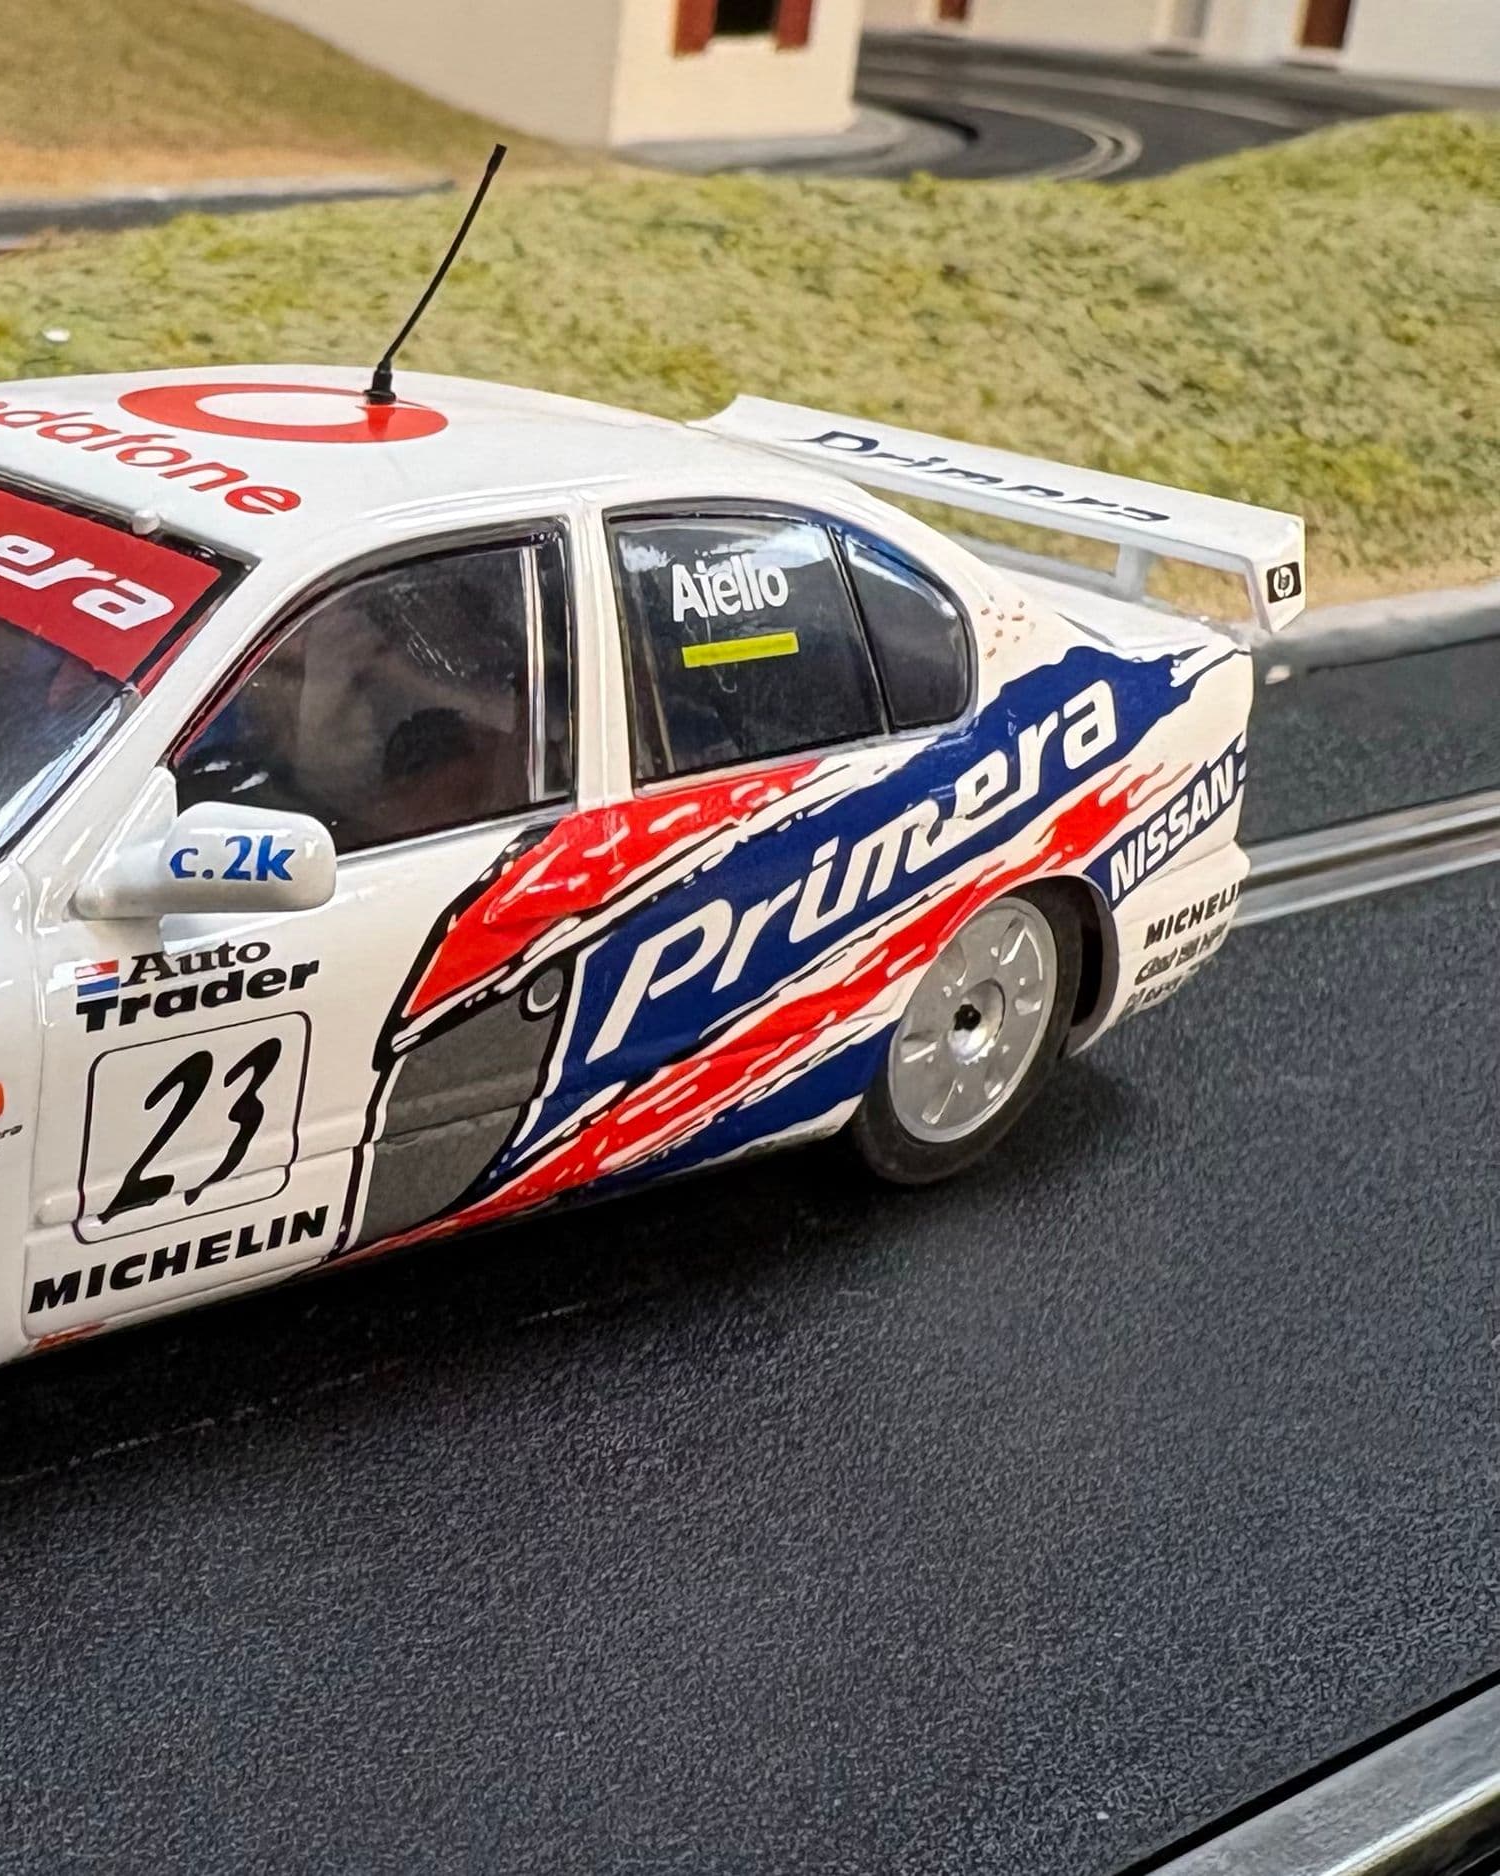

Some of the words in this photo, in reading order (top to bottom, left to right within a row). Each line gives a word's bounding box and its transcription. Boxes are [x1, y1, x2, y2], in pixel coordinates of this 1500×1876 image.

[672, 552, 789, 622] Aiello
[169, 835, 293, 881] c.2k
[584, 679, 1118, 1064] Primera
[1109, 754, 1234, 901] NISSAN
[76, 960, 319, 1033] Trader
[120, 940, 271, 986] Auto
[96, 1038, 282, 1224] 23
[28, 1206, 329, 1314] MICHELIN
